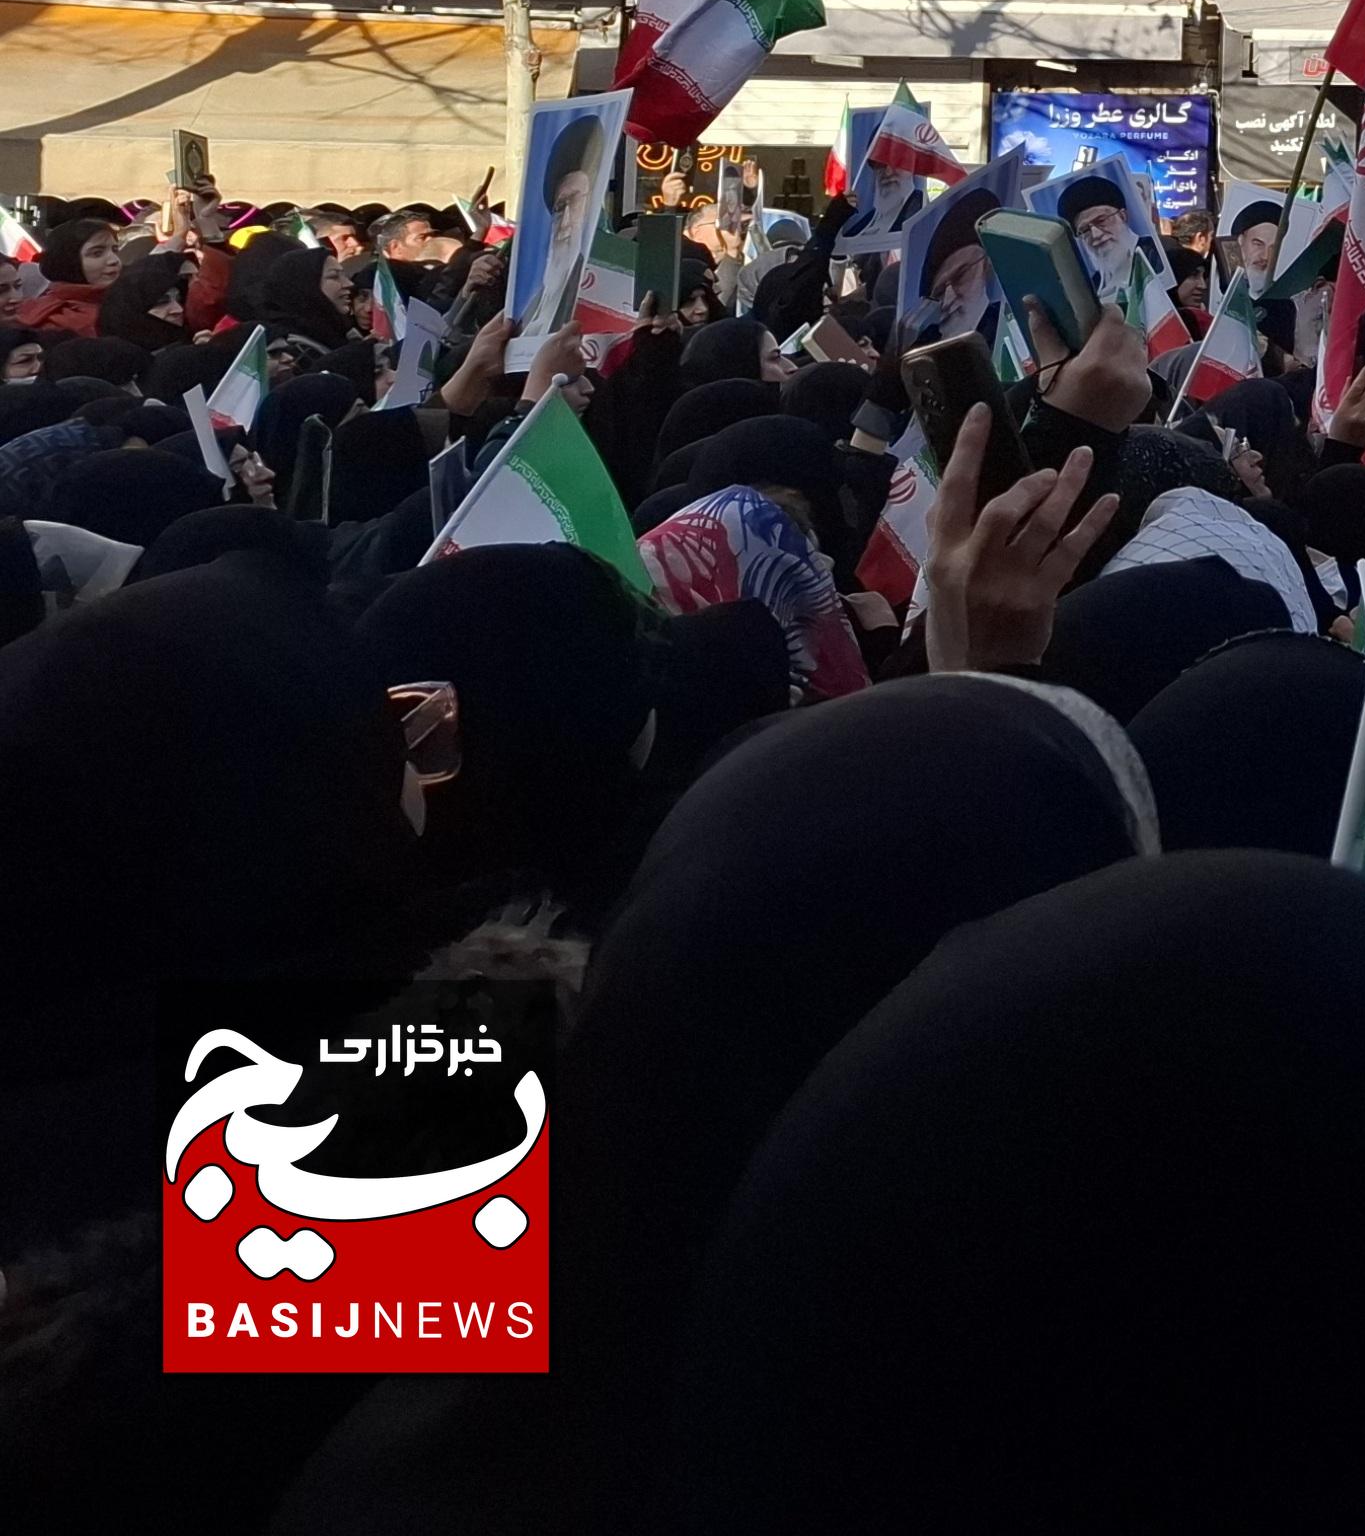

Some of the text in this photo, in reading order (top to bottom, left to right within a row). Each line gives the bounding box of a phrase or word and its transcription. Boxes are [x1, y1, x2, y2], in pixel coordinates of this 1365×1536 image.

[1049, 101, 1193, 129] گالری عطر وزرا
[1235, 113, 1267, 134] نصب
[1268, 110, 1306, 133] آگهی
[1120, 132, 1169, 141] PERFUME
